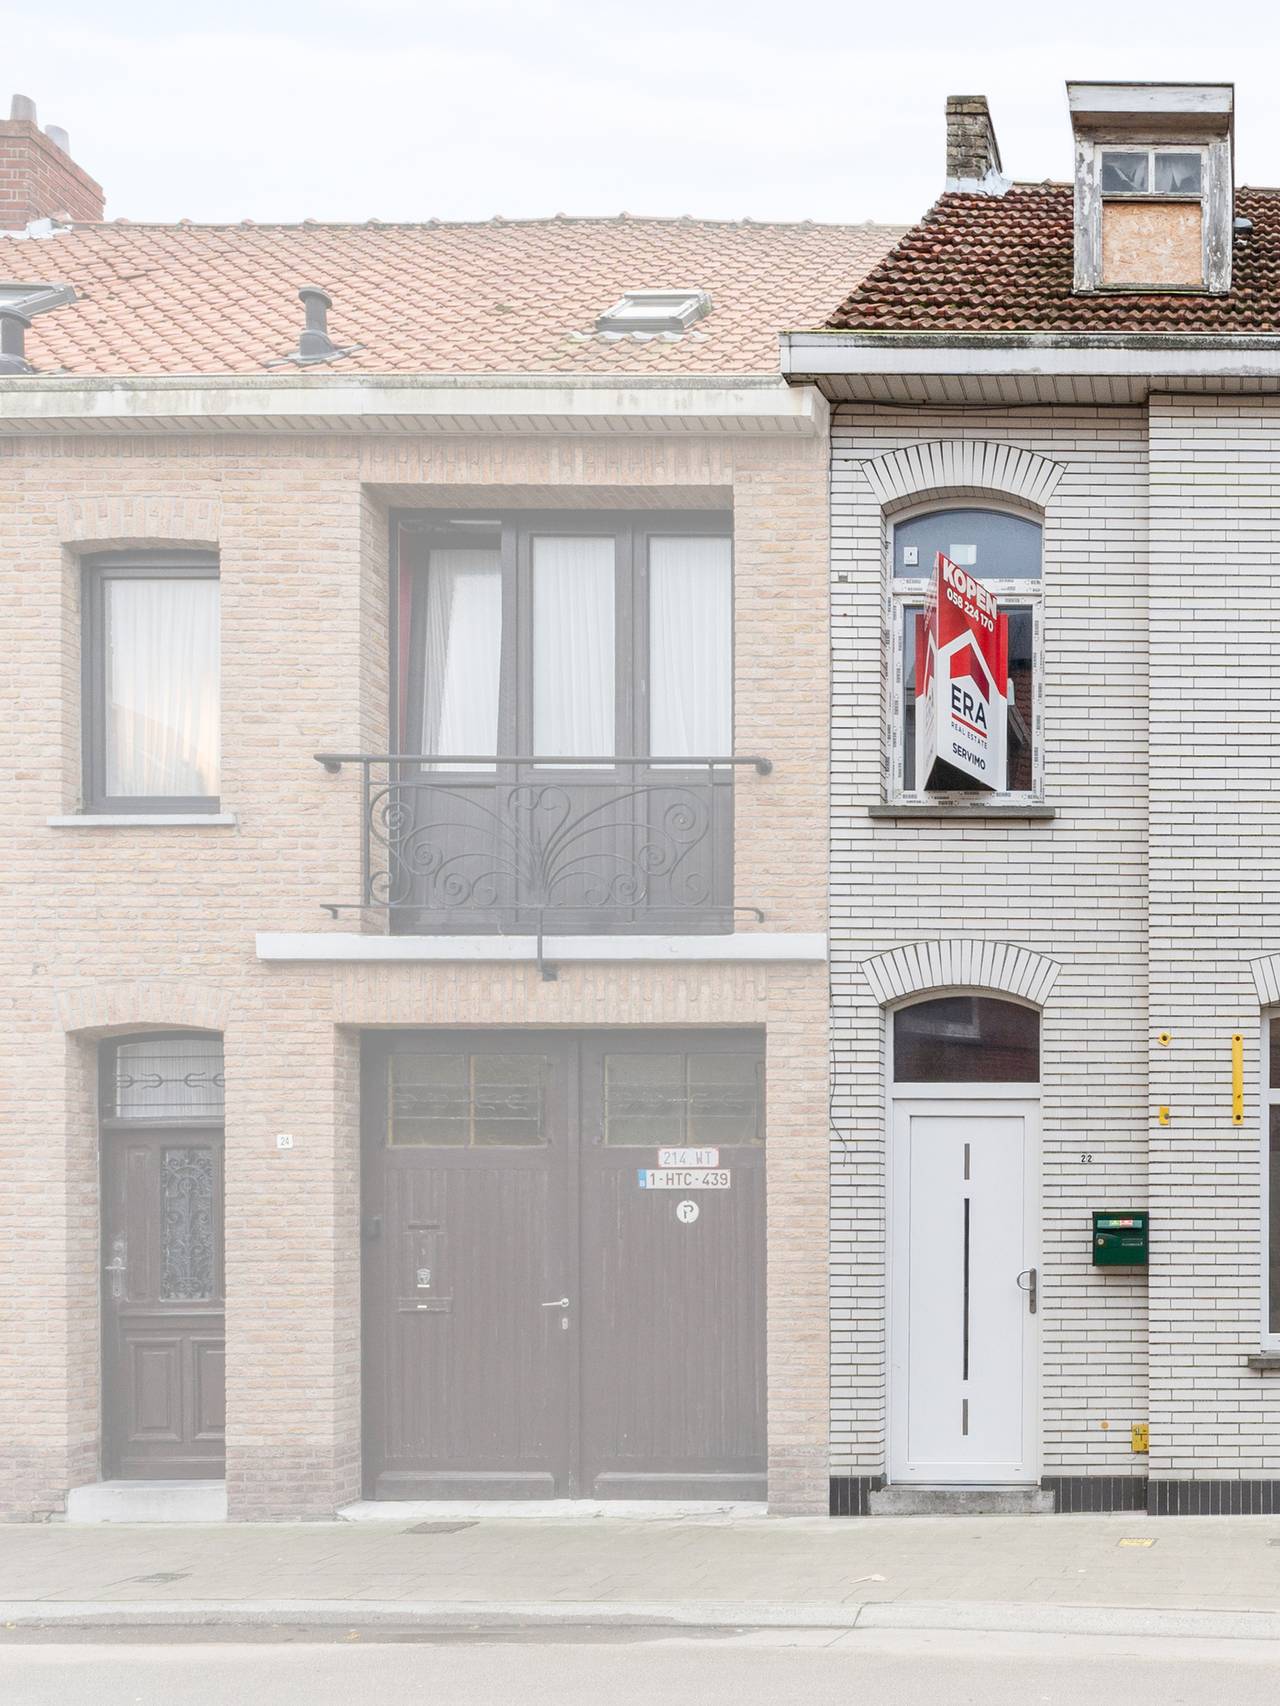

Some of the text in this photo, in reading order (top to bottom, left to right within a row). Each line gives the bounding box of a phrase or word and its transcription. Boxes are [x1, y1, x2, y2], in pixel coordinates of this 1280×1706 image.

[943, 557, 998, 620] KOPEN
[946, 587, 994, 633] 058 224 170
[951, 683, 988, 730] ERA
[951, 721, 988, 750] REAL ESTATE
[952, 742, 986, 771] SERVIMO
[279, 1136, 290, 1146] 24
[1080, 1154, 1093, 1164] 22
